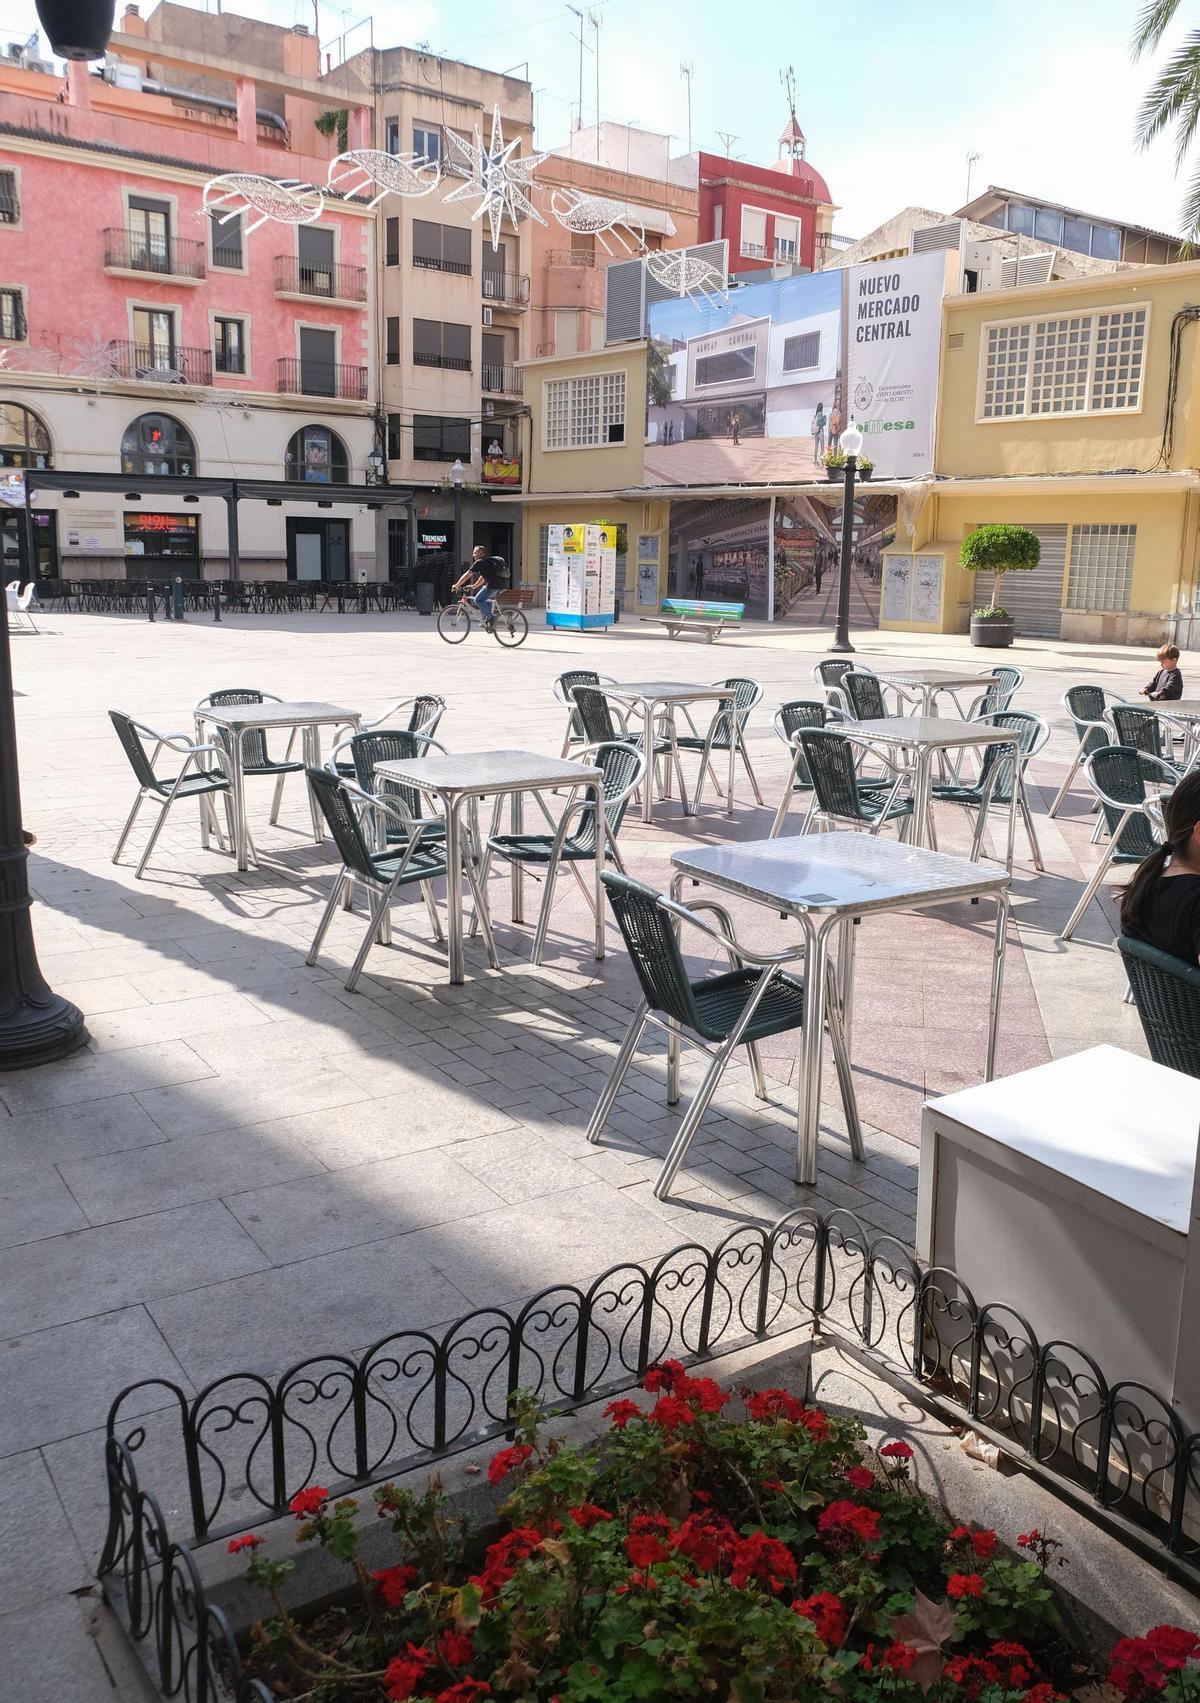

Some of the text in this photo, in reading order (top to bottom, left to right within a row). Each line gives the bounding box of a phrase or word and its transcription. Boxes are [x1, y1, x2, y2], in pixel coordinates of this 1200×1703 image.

[859, 274, 900, 296] NUEVO
[858, 294, 920, 320] MERCADO
[856, 320, 911, 343] CENTRAL
[421, 534, 448, 543] TREMENDA
